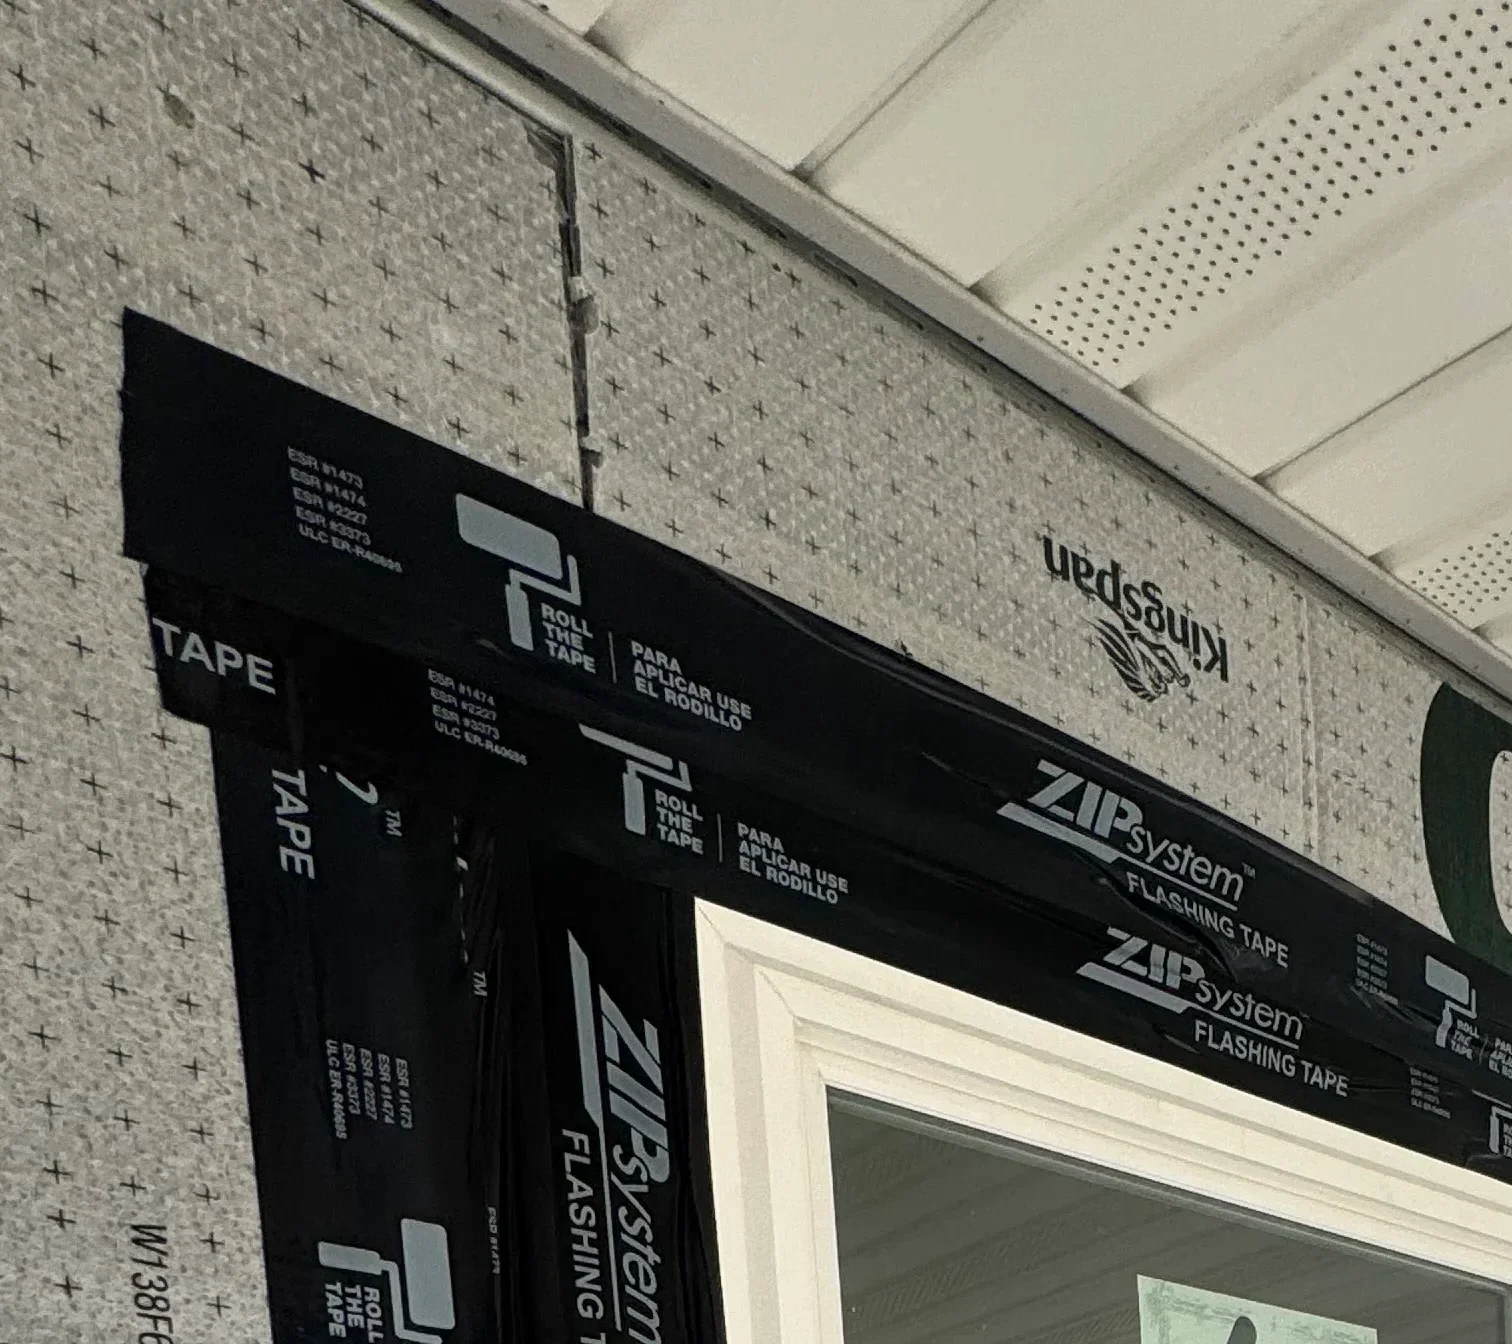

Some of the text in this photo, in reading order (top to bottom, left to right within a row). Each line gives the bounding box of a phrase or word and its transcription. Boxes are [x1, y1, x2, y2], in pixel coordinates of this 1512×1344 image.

[540, 602, 594, 639] ROLL
[1043, 535, 1230, 683] Kingspan
[152, 615, 278, 696] TAPE
[543, 622, 585, 651] THE
[545, 638, 596, 674] TAPE
[630, 640, 682, 675] PARA
[633, 661, 752, 720] APLICAR USE
[635, 676, 743, 732] EL RODILLO
[271, 767, 315, 880] TAPE
[655, 789, 703, 821] ROLL
[656, 807, 693, 834] THE
[657, 824, 703, 855] TAPE
[737, 822, 784, 853] PARA
[739, 840, 849, 894] APLICAR USE
[739, 855, 838, 905] EL RODILLO
[1126, 871, 1290, 969] FLASHING TAPE
[1193, 1019, 1349, 1098] FLASHING TAPE
[562, 1128, 603, 1321] FLASHING
[324, 1281, 347, 1339] TAPE
[344, 1283, 365, 1329] THE
[363, 1286, 384, 1344] ROLL
